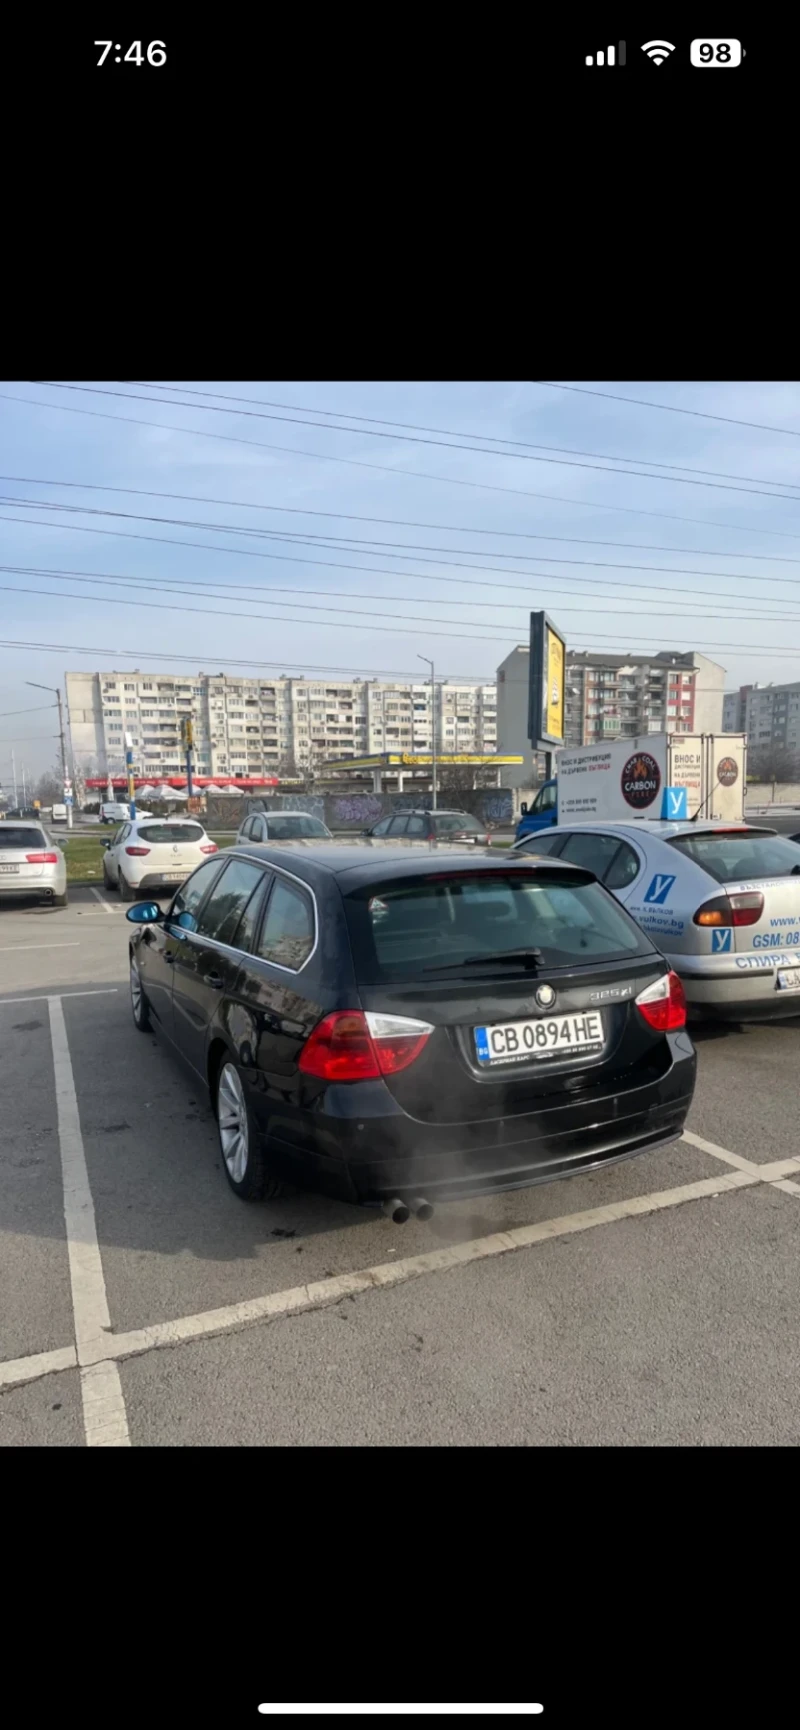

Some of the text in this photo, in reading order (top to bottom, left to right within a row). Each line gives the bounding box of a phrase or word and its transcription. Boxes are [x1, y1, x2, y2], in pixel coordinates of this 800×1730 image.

[625, 758, 637, 773] CHAR
[642, 755, 656, 771] COAL
[674, 754, 694, 763] ВНОС
[625, 780, 656, 791] CARBON
[752, 934, 784, 948] GSM:
[735, 954, 791, 969] СПИРА
[491, 1016, 600, 1054] CB 0894 HE
[478, 1047, 488, 1056] BG
